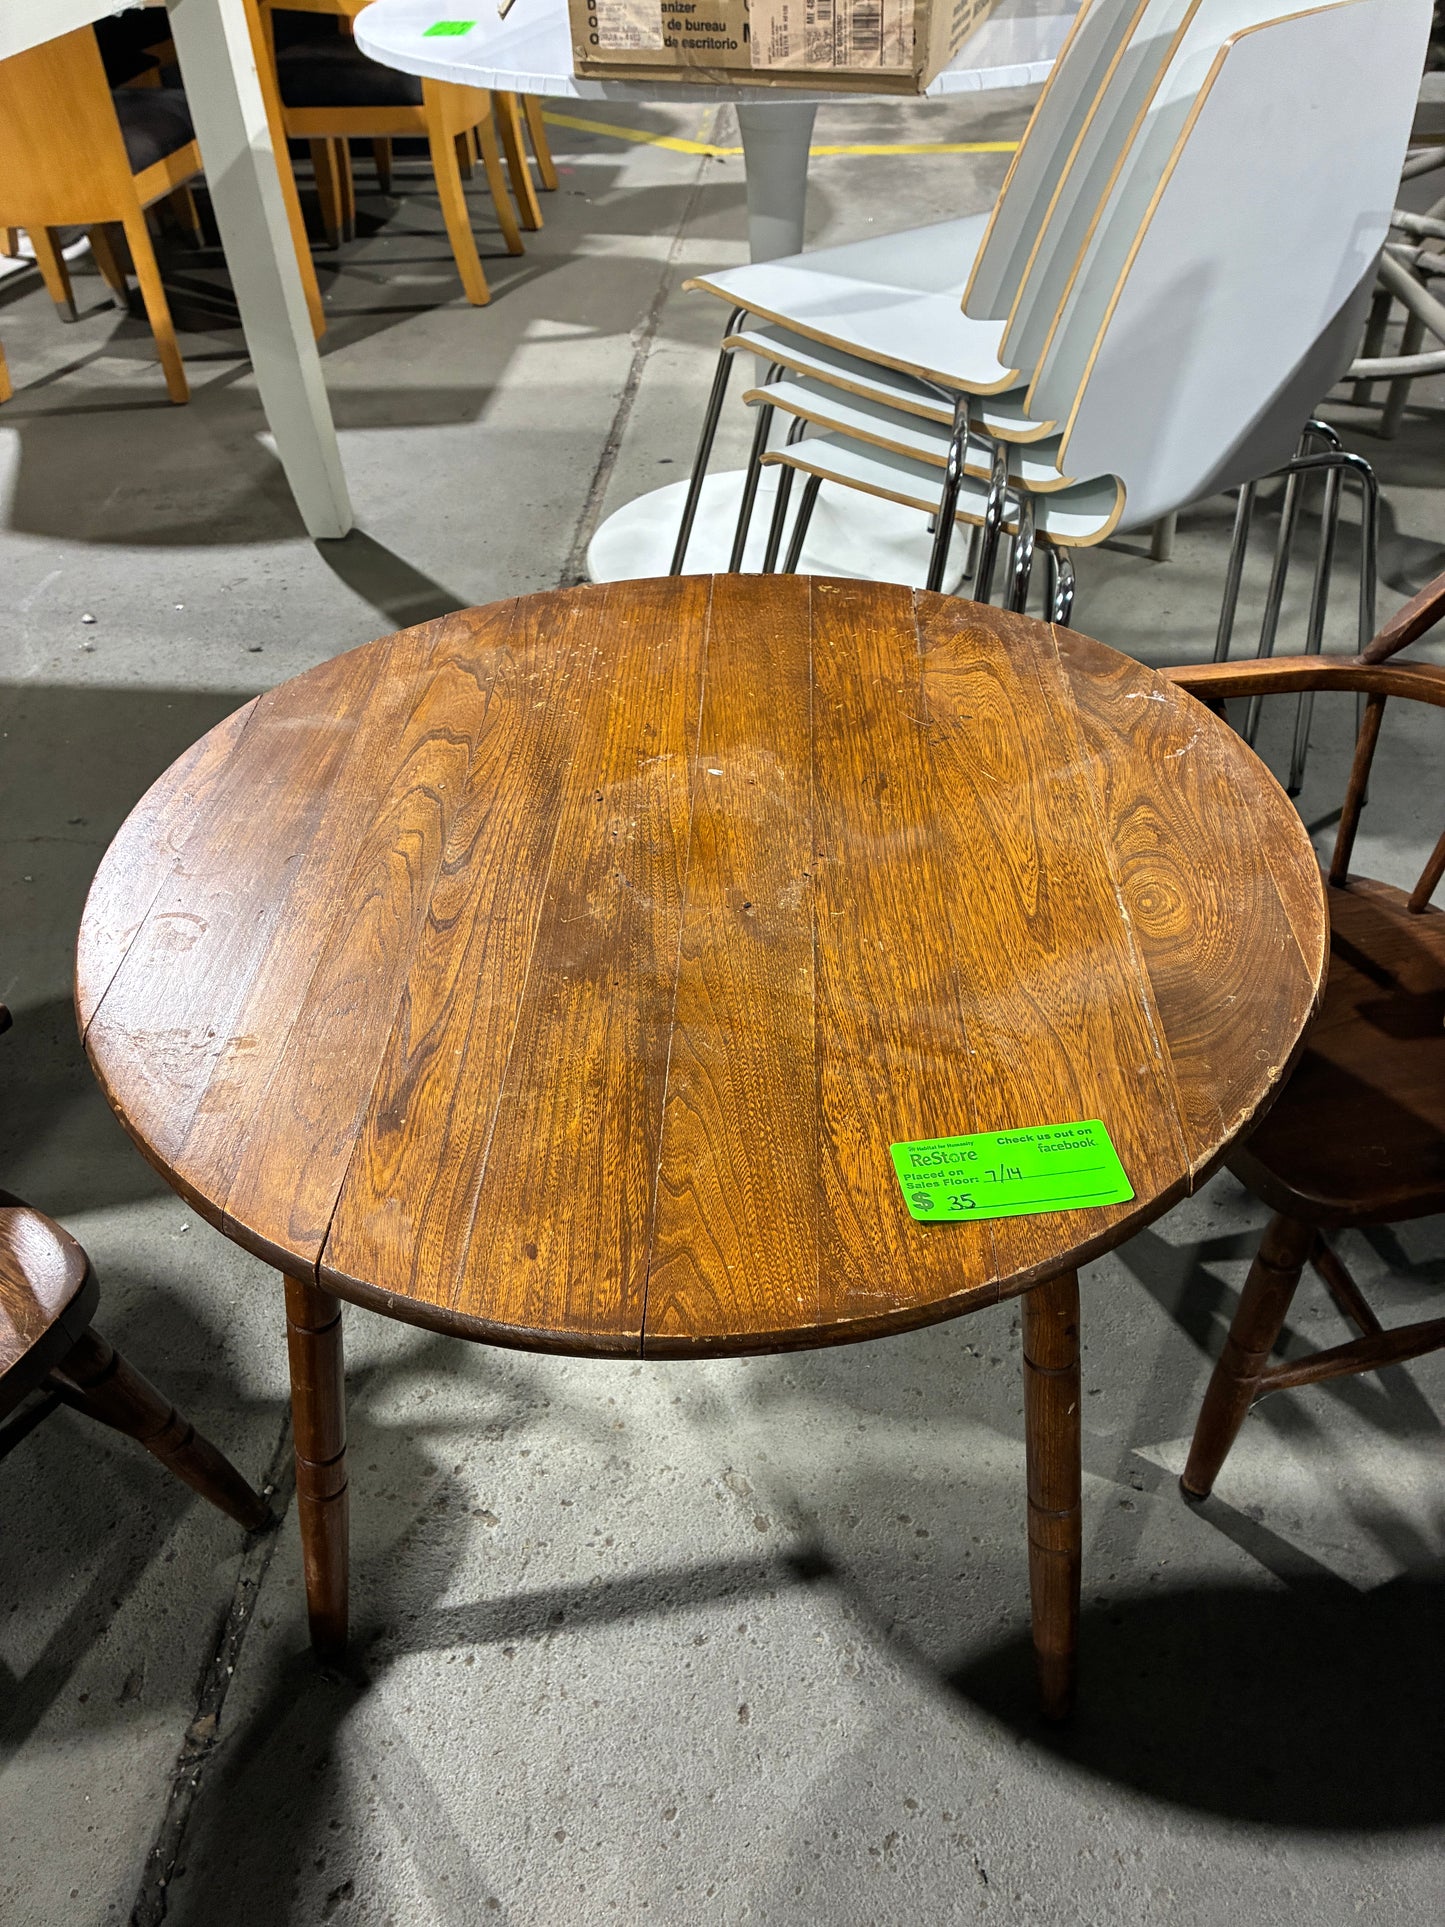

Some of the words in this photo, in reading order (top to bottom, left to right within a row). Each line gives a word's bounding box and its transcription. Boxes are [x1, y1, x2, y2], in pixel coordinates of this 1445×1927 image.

[661, 3, 696, 13] anizer
[668, 19, 682, 31] de
[686, 19, 726, 32] bureau
[665, 36, 679, 48] de
[682, 37, 738, 50] escritorio
[947, 1140, 974, 1149] Humanity
[996, 1134, 1034, 1145] Check
[1054, 1131, 1074, 1139] out
[910, 1150, 978, 1167] ReStore
[904, 1170, 944, 1181] Placed
[906, 1180, 940, 1190] Sales
[943, 1177, 980, 1186] Floor:
[911, 1191, 935, 1212] $
[947, 1194, 977, 1210] 35
